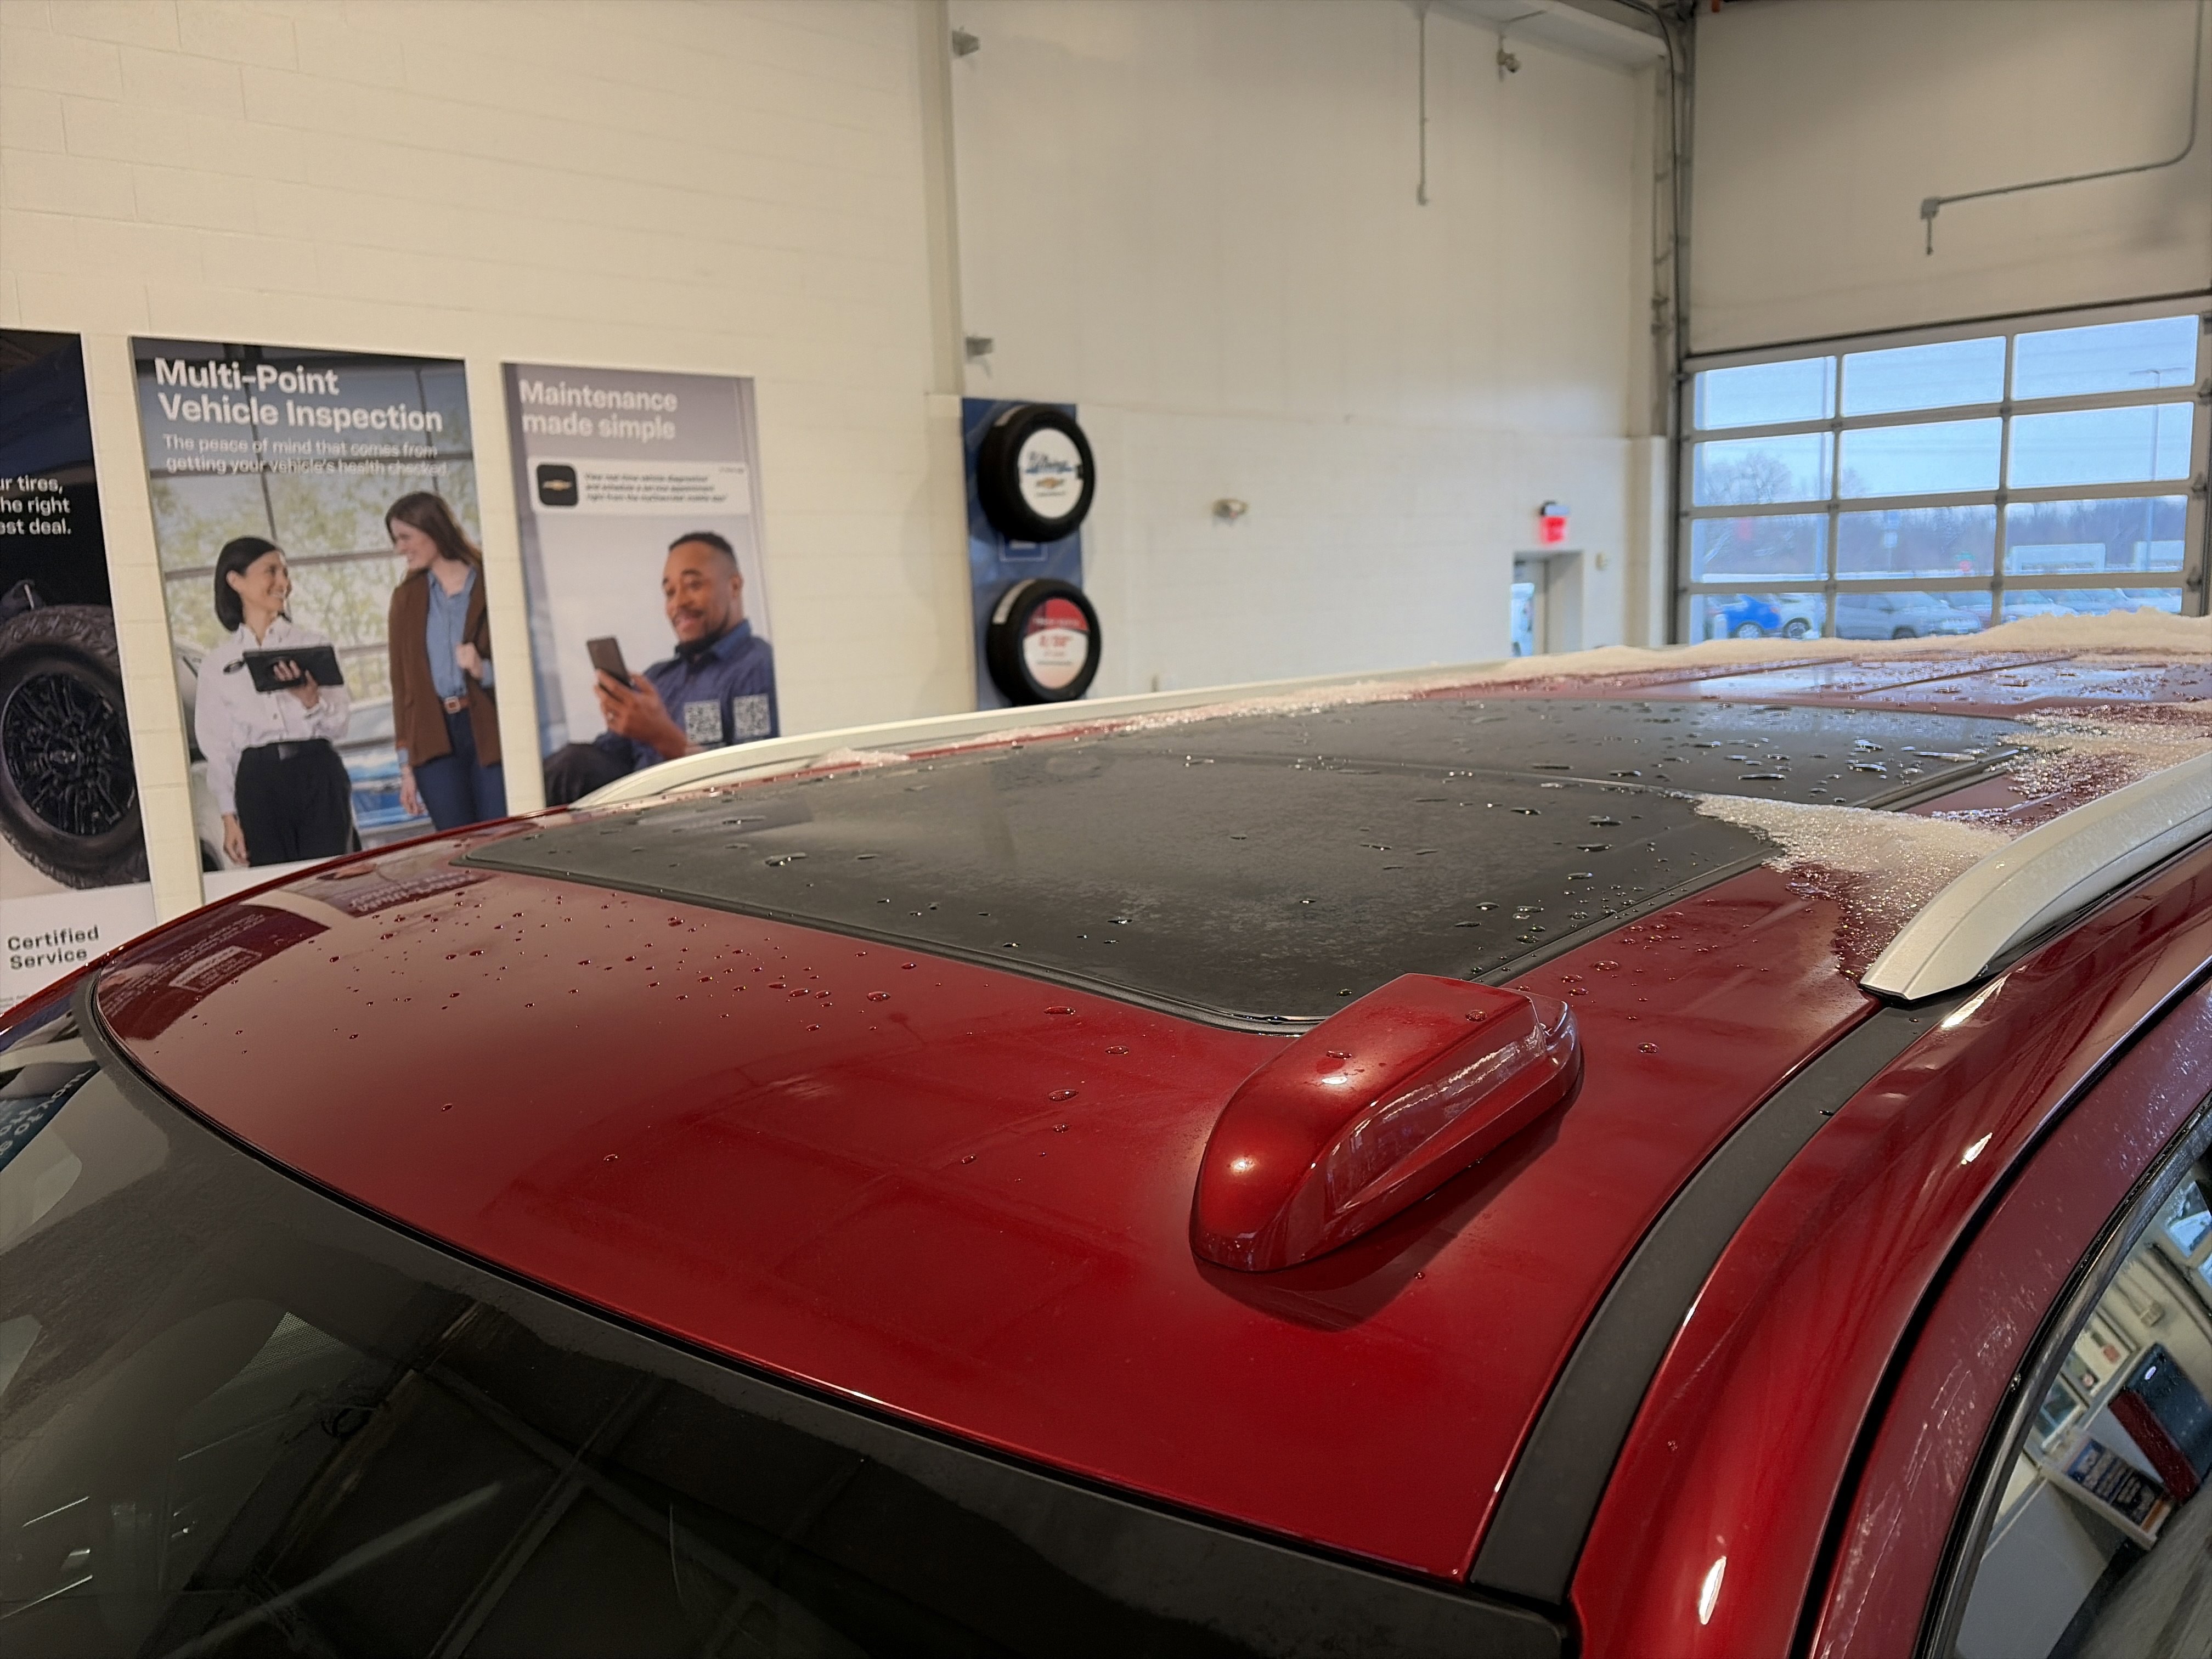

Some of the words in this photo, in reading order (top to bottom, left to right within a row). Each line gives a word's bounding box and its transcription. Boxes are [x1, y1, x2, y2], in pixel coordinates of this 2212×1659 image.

[154, 357, 340, 396] Multi-Point
[518, 379, 678, 413] Maintenance
[158, 391, 279, 426] Vehicle
[286, 398, 443, 433] Inspection
[522, 410, 594, 437] made
[597, 412, 676, 444] simple
[163, 433, 195, 452] The
[199, 438, 248, 454] peace
[252, 437, 269, 454] of
[273, 438, 312, 455] mind
[315, 439, 347, 456] that
[350, 442, 400, 458] comes
[402, 441, 438, 459] from
[166, 455, 227, 475] getting
[230, 460, 264, 475] your
[337, 458, 385, 476] health
[17, 474, 63, 495] tires,
[27, 496, 71, 516] right
[29, 517, 72, 535] deal.
[8, 924, 99, 951] Certified
[10, 947, 88, 970] Service
